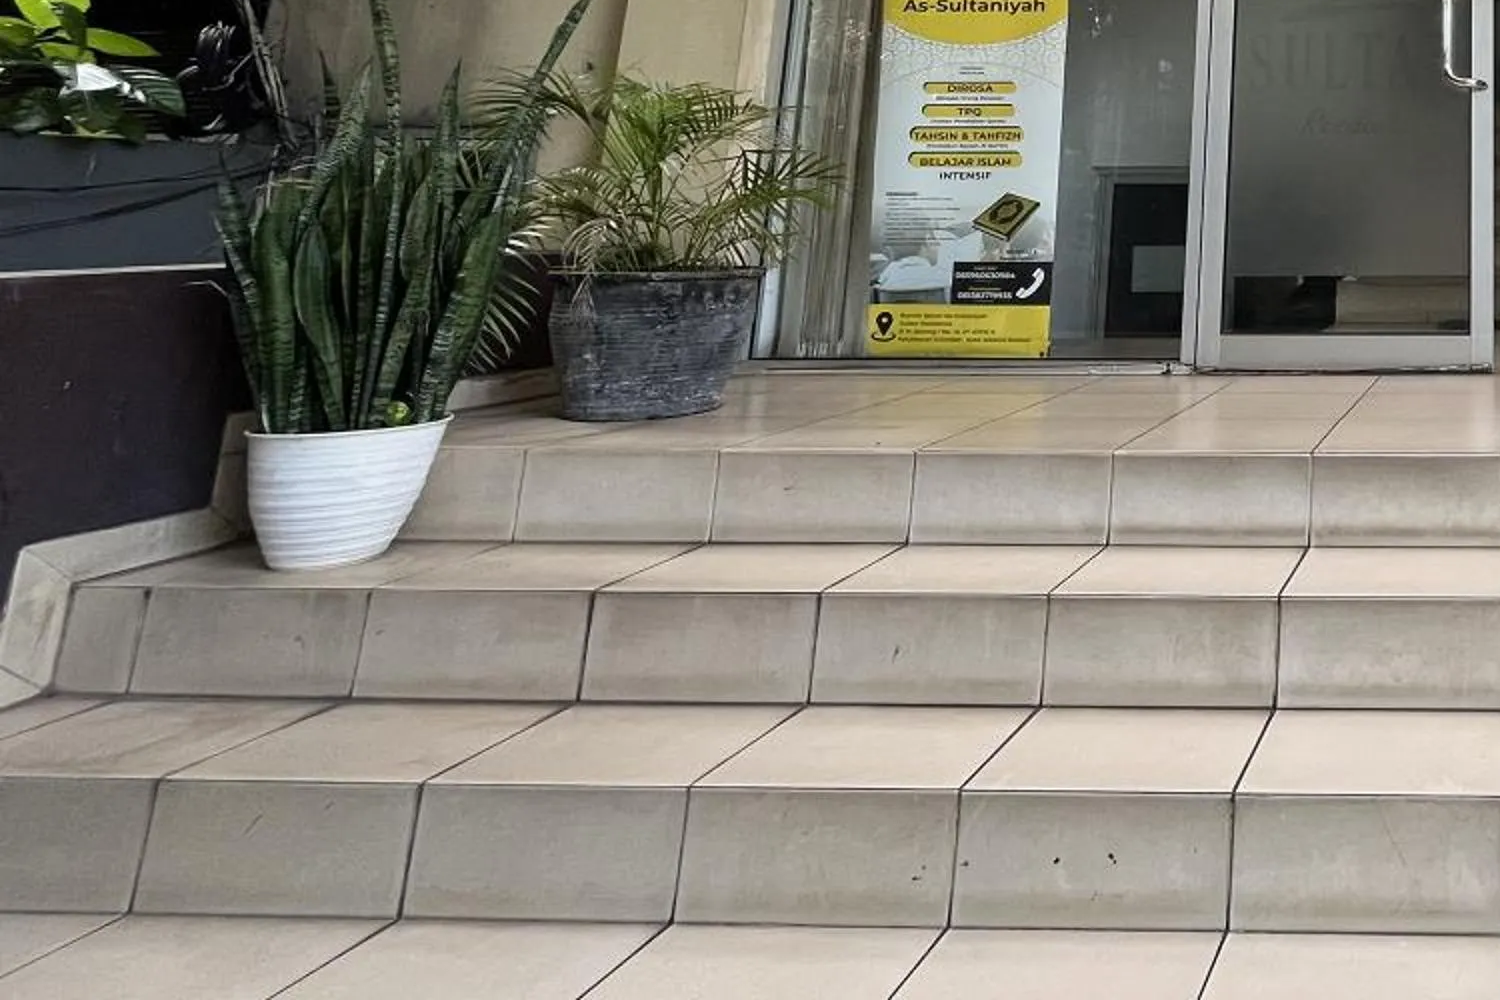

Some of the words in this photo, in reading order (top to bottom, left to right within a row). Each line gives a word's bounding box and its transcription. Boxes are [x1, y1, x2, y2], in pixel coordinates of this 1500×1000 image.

[956, 108, 982, 117] TPQ
[914, 132, 958, 141] TAHSIN
[973, 132, 1021, 141] TAHFIZH
[919, 157, 974, 167] BELAJAR
[977, 157, 1011, 167] ISLAM
[939, 171, 992, 180] INTENSIF
